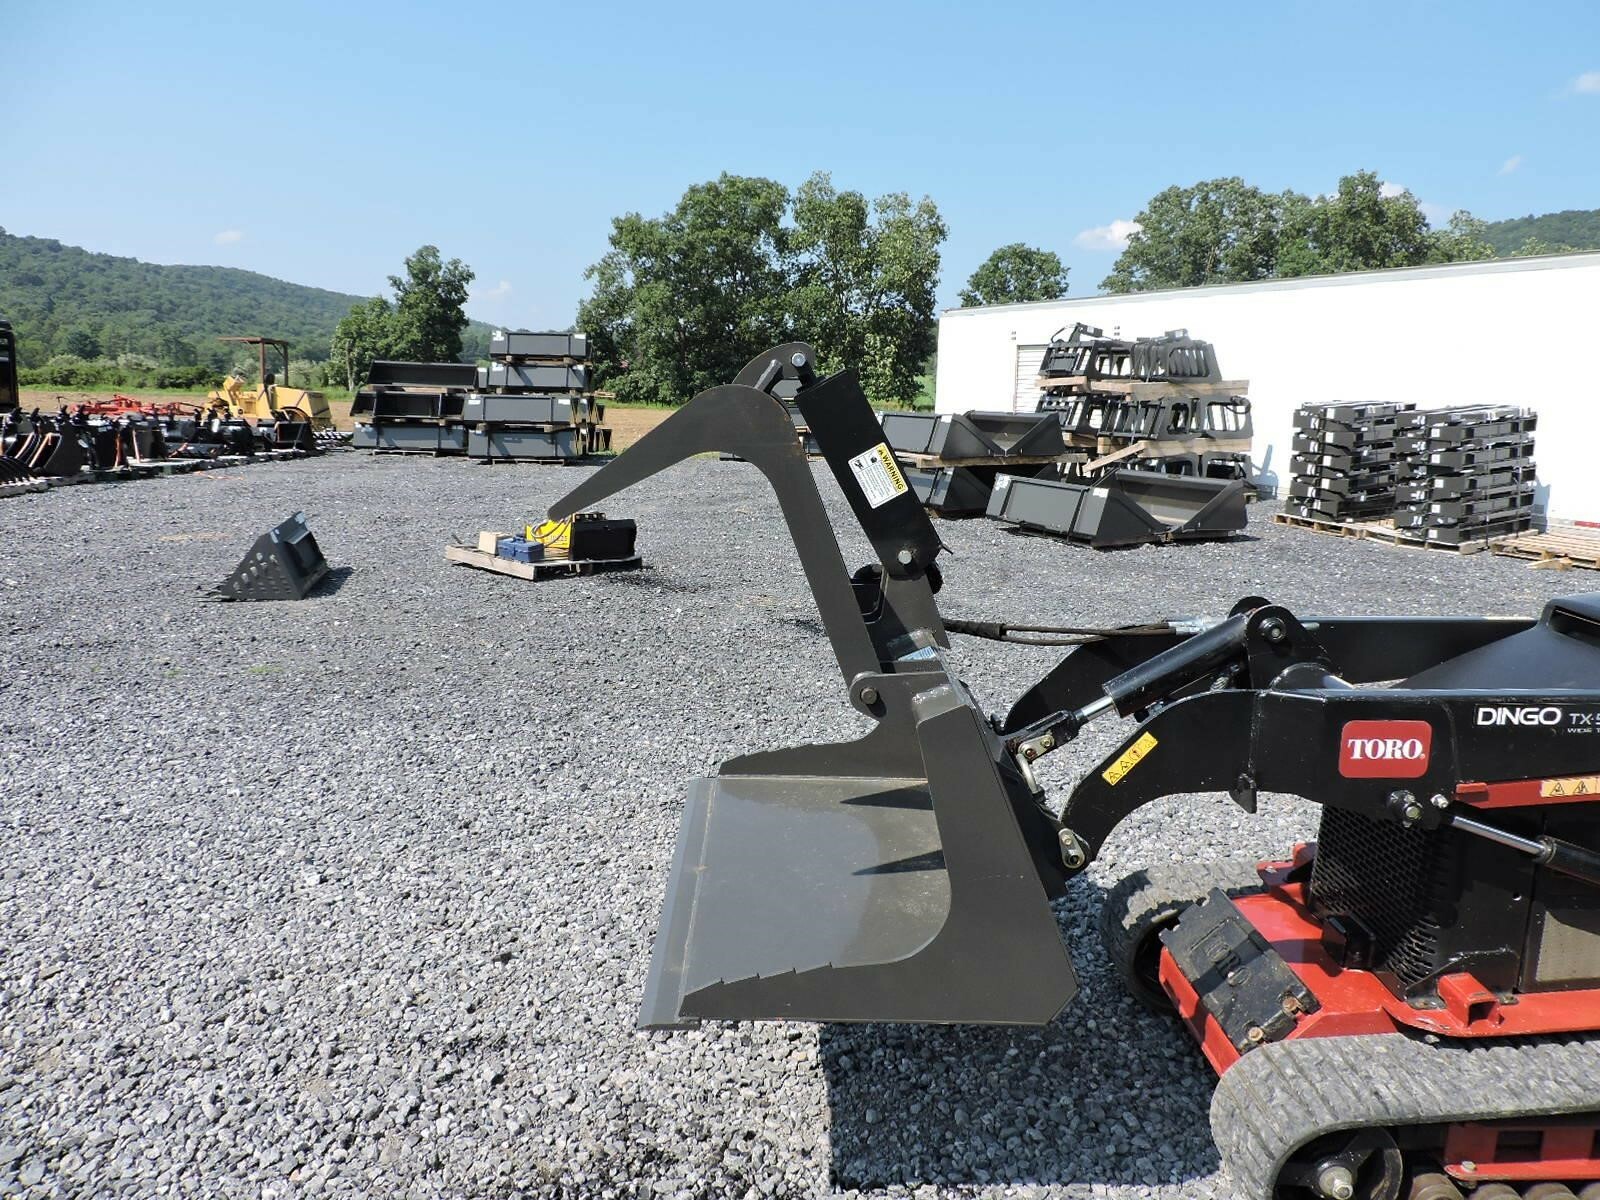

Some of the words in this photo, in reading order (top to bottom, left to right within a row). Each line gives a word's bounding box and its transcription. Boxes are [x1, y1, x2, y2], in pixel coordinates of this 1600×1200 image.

[882, 454, 904, 490] WARNING
[1477, 707, 1562, 726] DINGO
[1347, 738, 1424, 760] TORO
